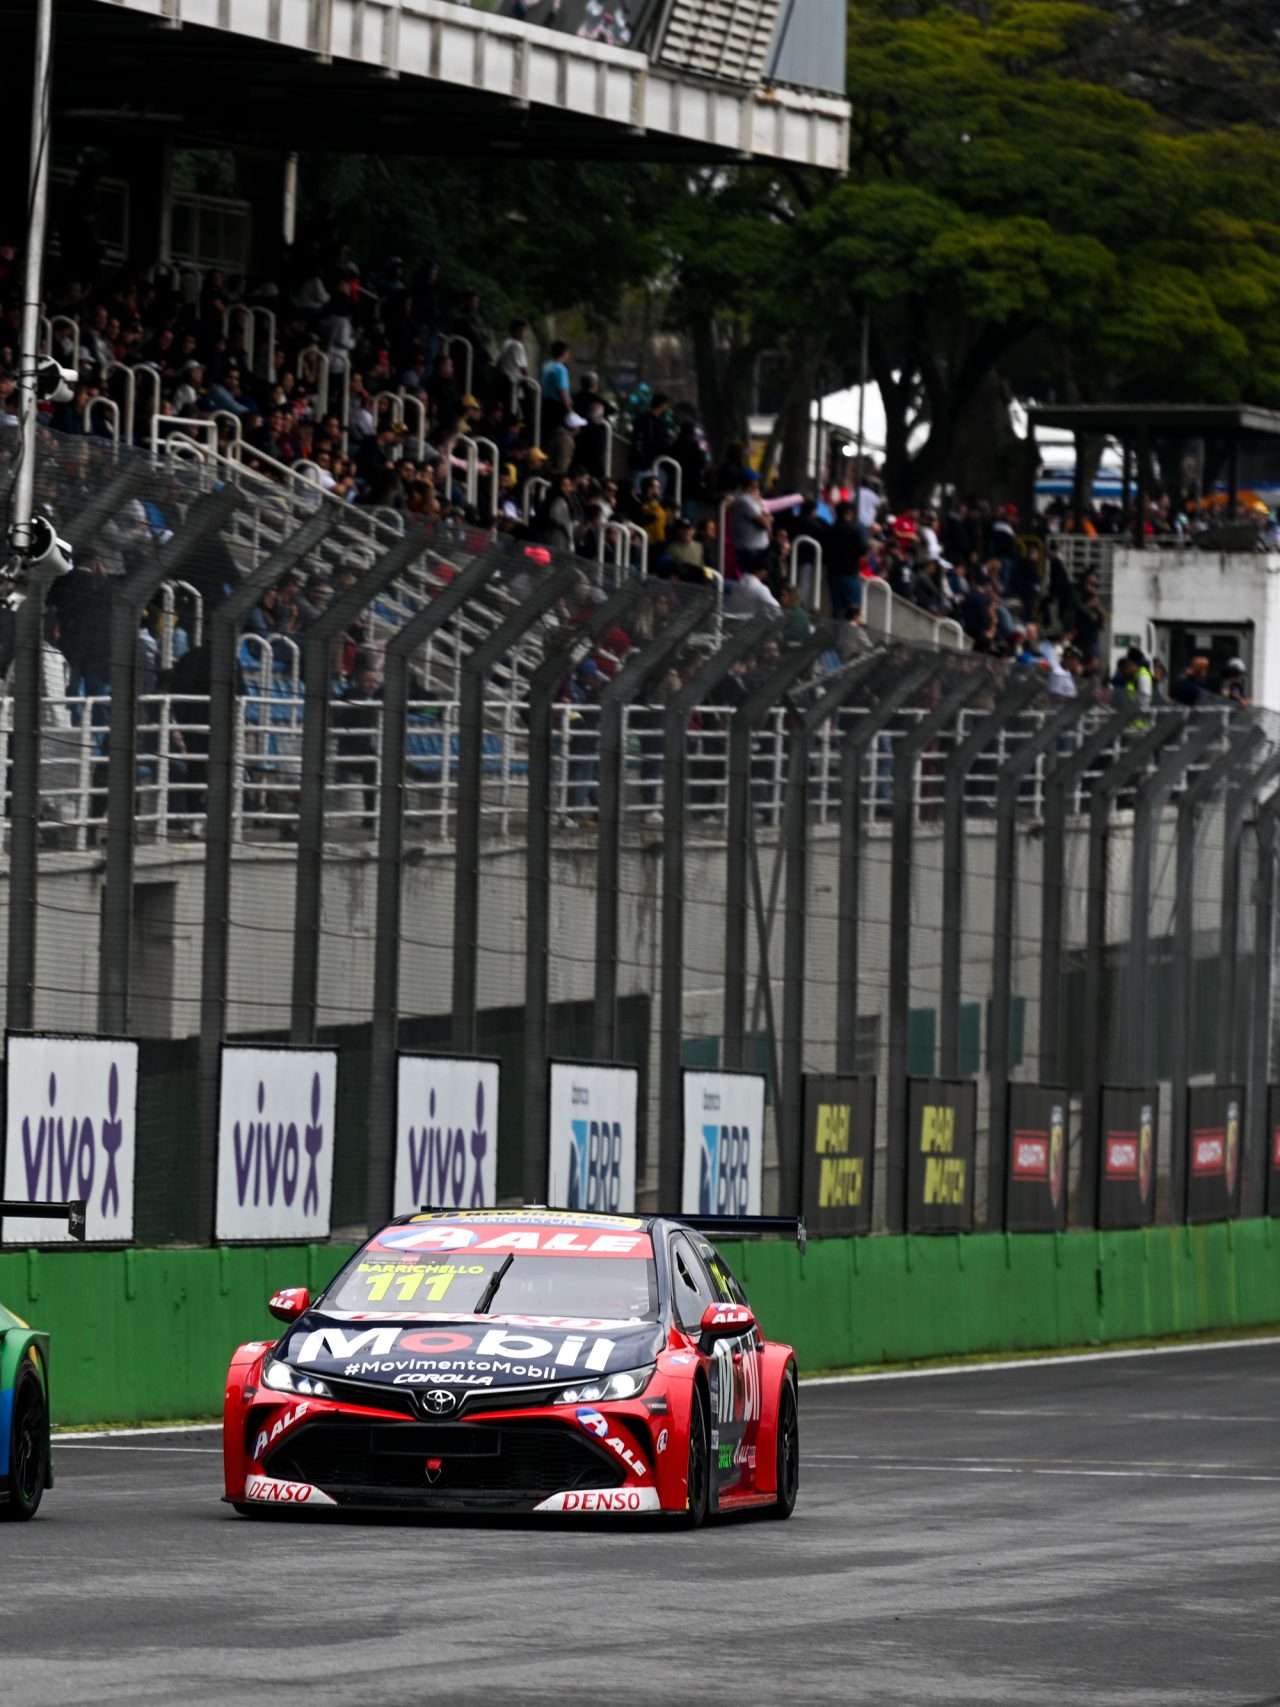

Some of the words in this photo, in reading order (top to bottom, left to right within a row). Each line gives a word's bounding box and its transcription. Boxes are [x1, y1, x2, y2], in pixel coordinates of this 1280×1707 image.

[22, 1071, 96, 1201] vivo
[234, 1080, 299, 1207] vivo
[409, 1087, 467, 1207] vivo
[588, 1121, 623, 1212] BRB
[718, 1125, 751, 1216] BRB
[475, 1232, 643, 1253] ALE
[357, 1263, 485, 1275] BARRICHELLO
[365, 1273, 455, 1301] 111
[269, 1297, 295, 1310] ALE
[297, 1327, 616, 1372] Mobil
[393, 1373, 494, 1386] COROLLA
[270, 1401, 310, 1442] ALE
[605, 1437, 646, 1476] ALE
[249, 1480, 314, 1503] DENSO
[562, 1493, 640, 1511] DENSO
